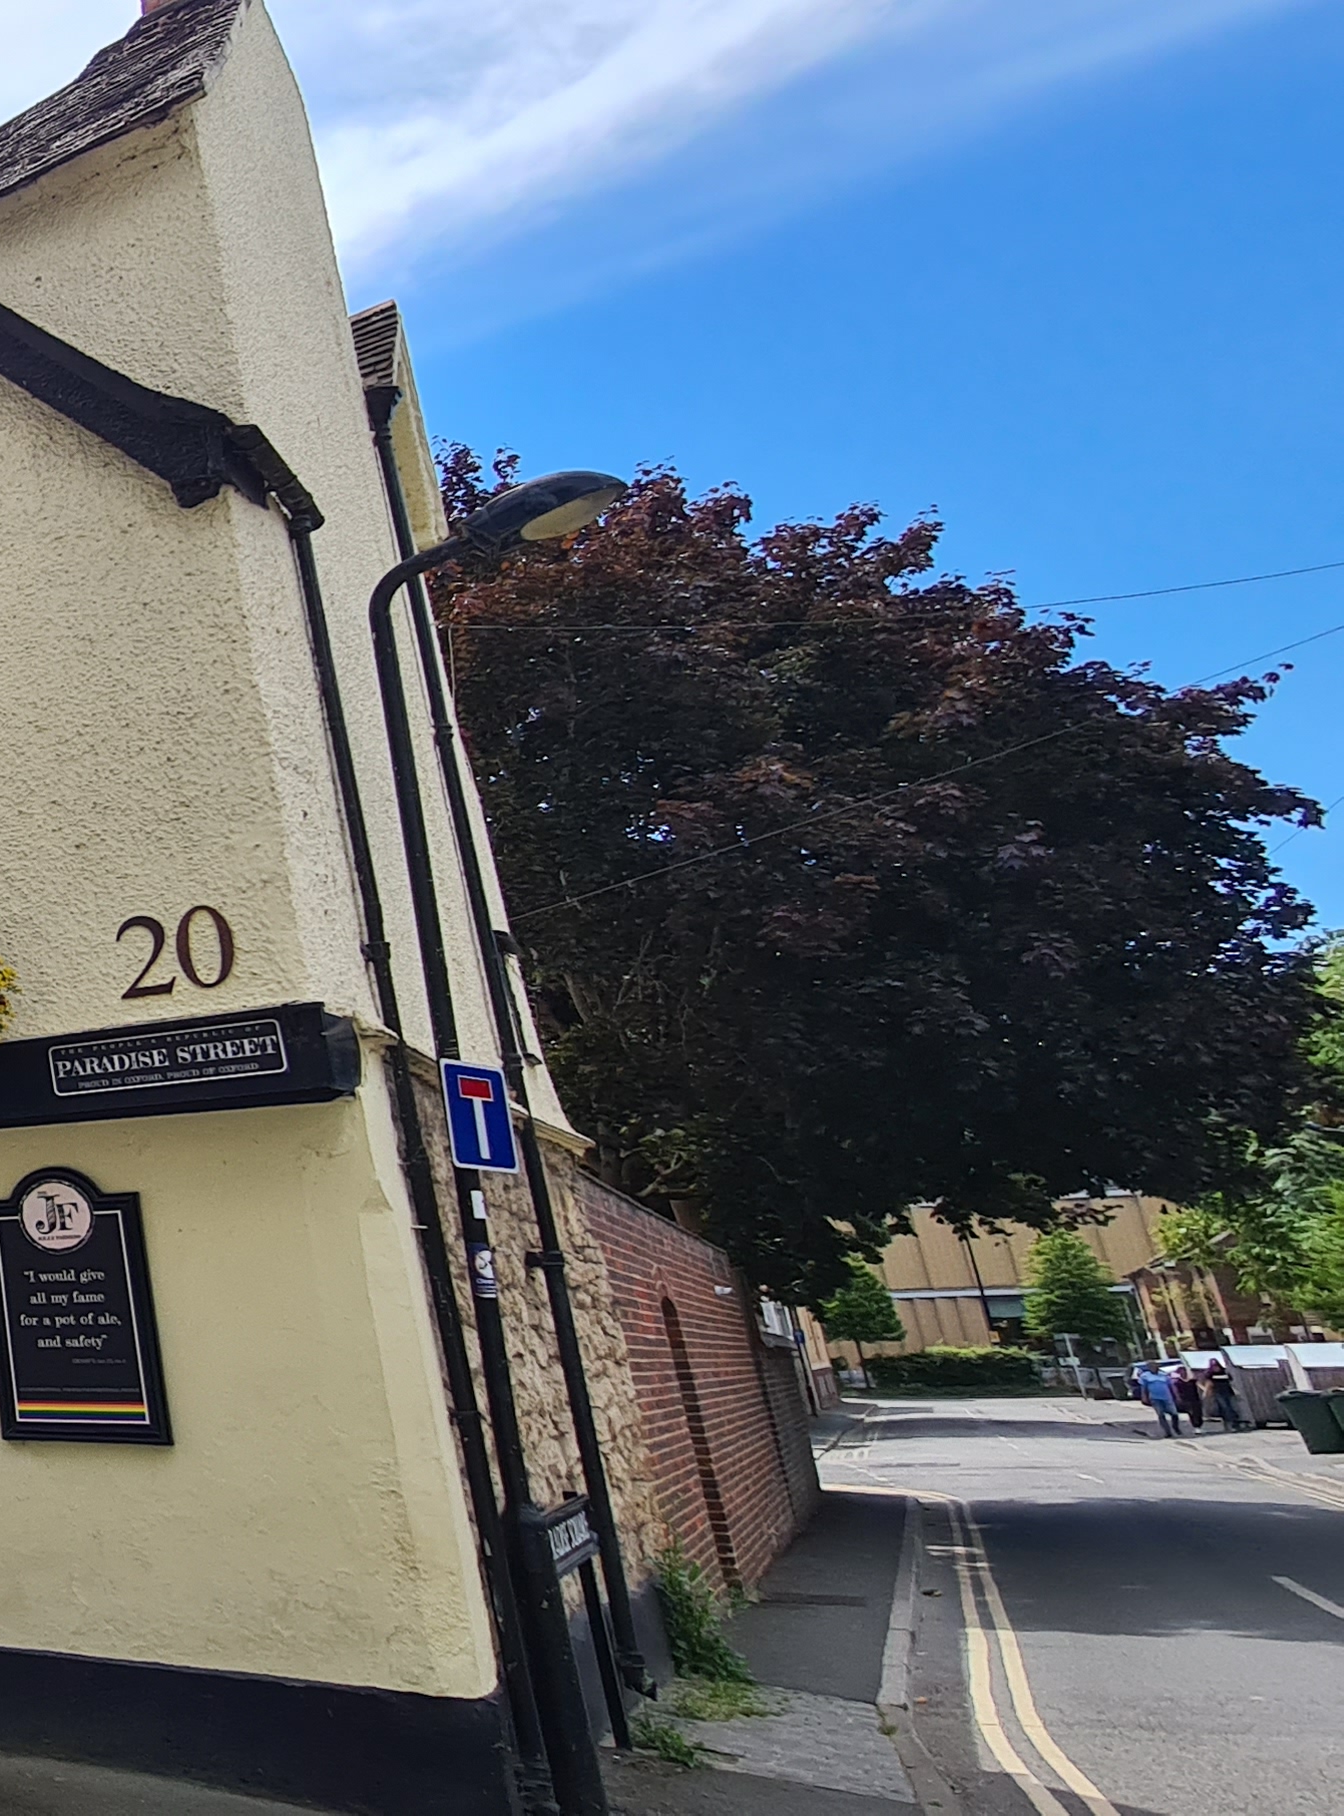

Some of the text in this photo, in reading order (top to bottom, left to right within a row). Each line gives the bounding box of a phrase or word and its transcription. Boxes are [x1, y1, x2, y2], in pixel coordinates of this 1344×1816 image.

[116, 905, 235, 1000] 20
[54, 1035, 277, 1078] PARADISE STREET
[60, 1047, 83, 1056] THE
[77, 1078, 110, 1089] PROUD
[111, 1077, 123, 1086] IN
[166, 1069, 200, 1080] PROUD
[202, 1066, 216, 1075] OF
[218, 1062, 260, 1073] OXFORD
[38, 1268, 77, 1282] would
[79, 1268, 105, 1284] give
[29, 1290, 105, 1307] all my fame
[20, 1313, 39, 1326] for
[42, 1316, 51, 1326] a
[54, 1314, 76, 1329] pot
[79, 1312, 94, 1325] of
[37, 1334, 62, 1348] and
